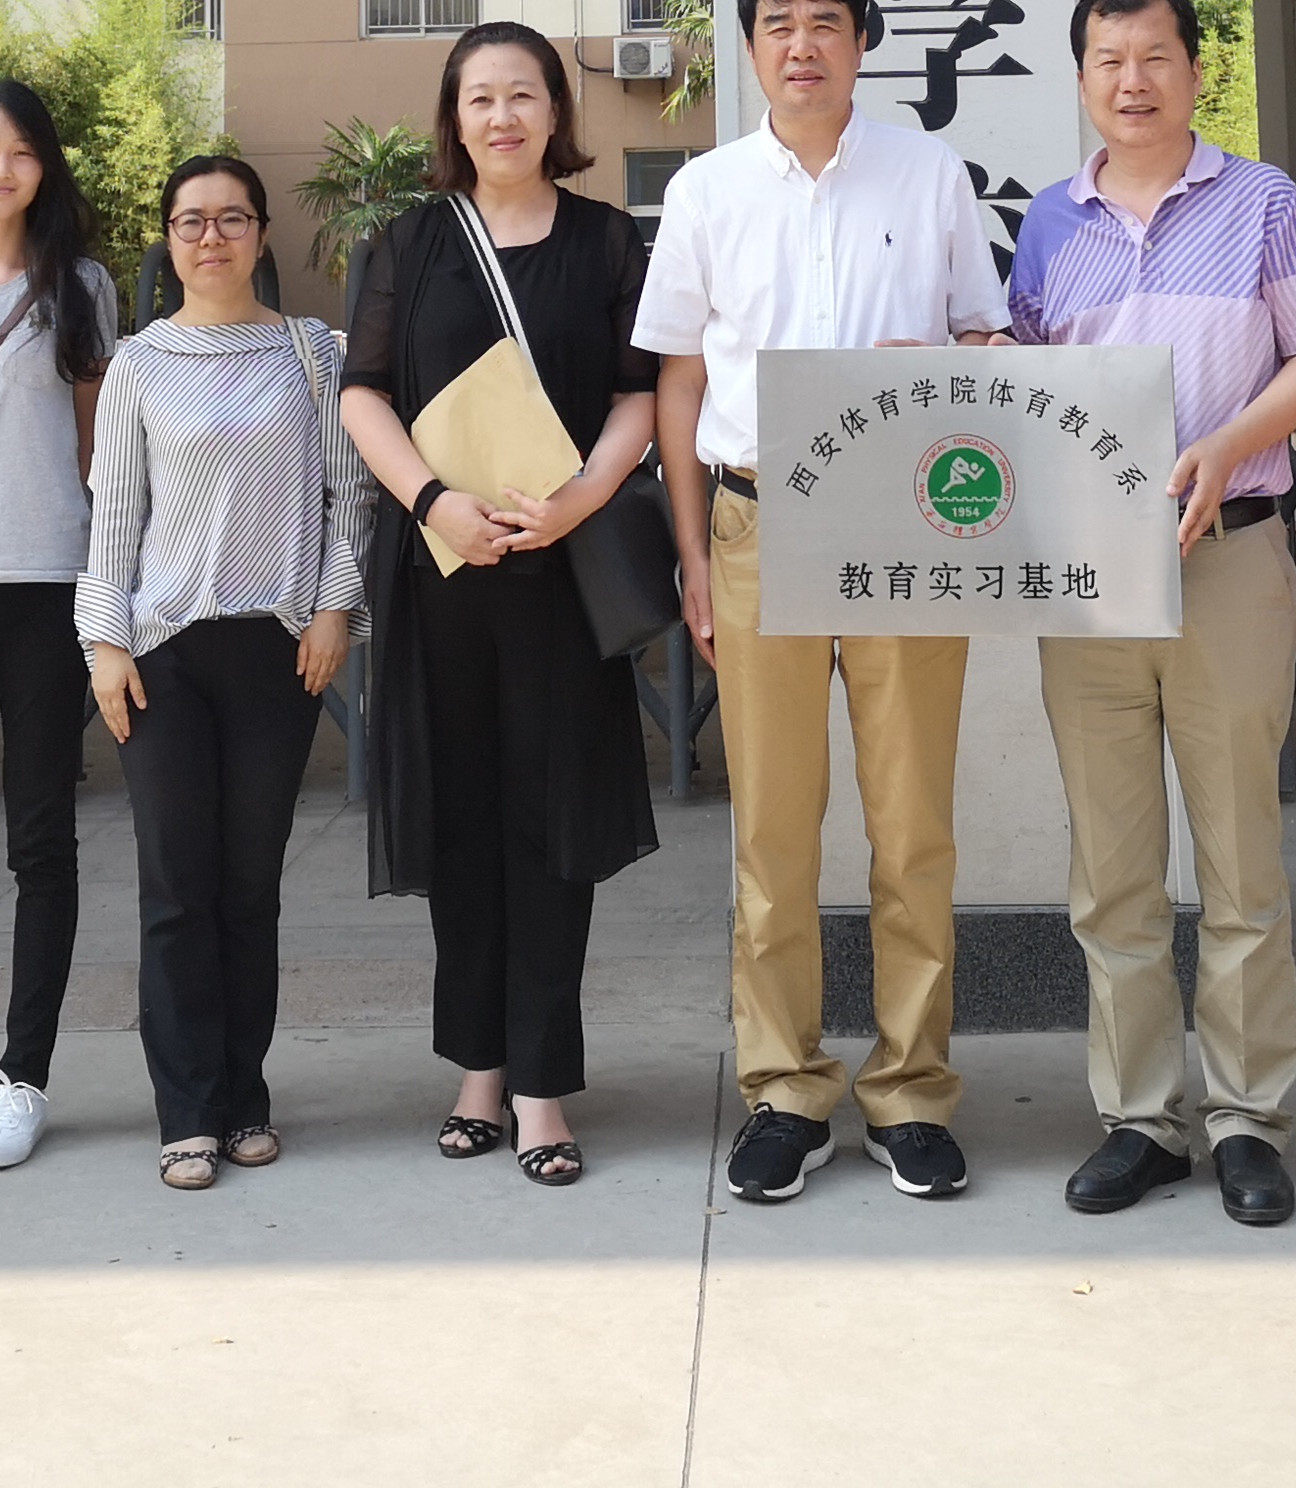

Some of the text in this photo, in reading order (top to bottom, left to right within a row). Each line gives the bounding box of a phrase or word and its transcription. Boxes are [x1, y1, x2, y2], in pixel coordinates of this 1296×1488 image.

[785, 375, 1148, 497] 西安体育学院体育教育系
[951, 506, 981, 518] 1954
[838, 560, 1101, 601] 教育实习基地
